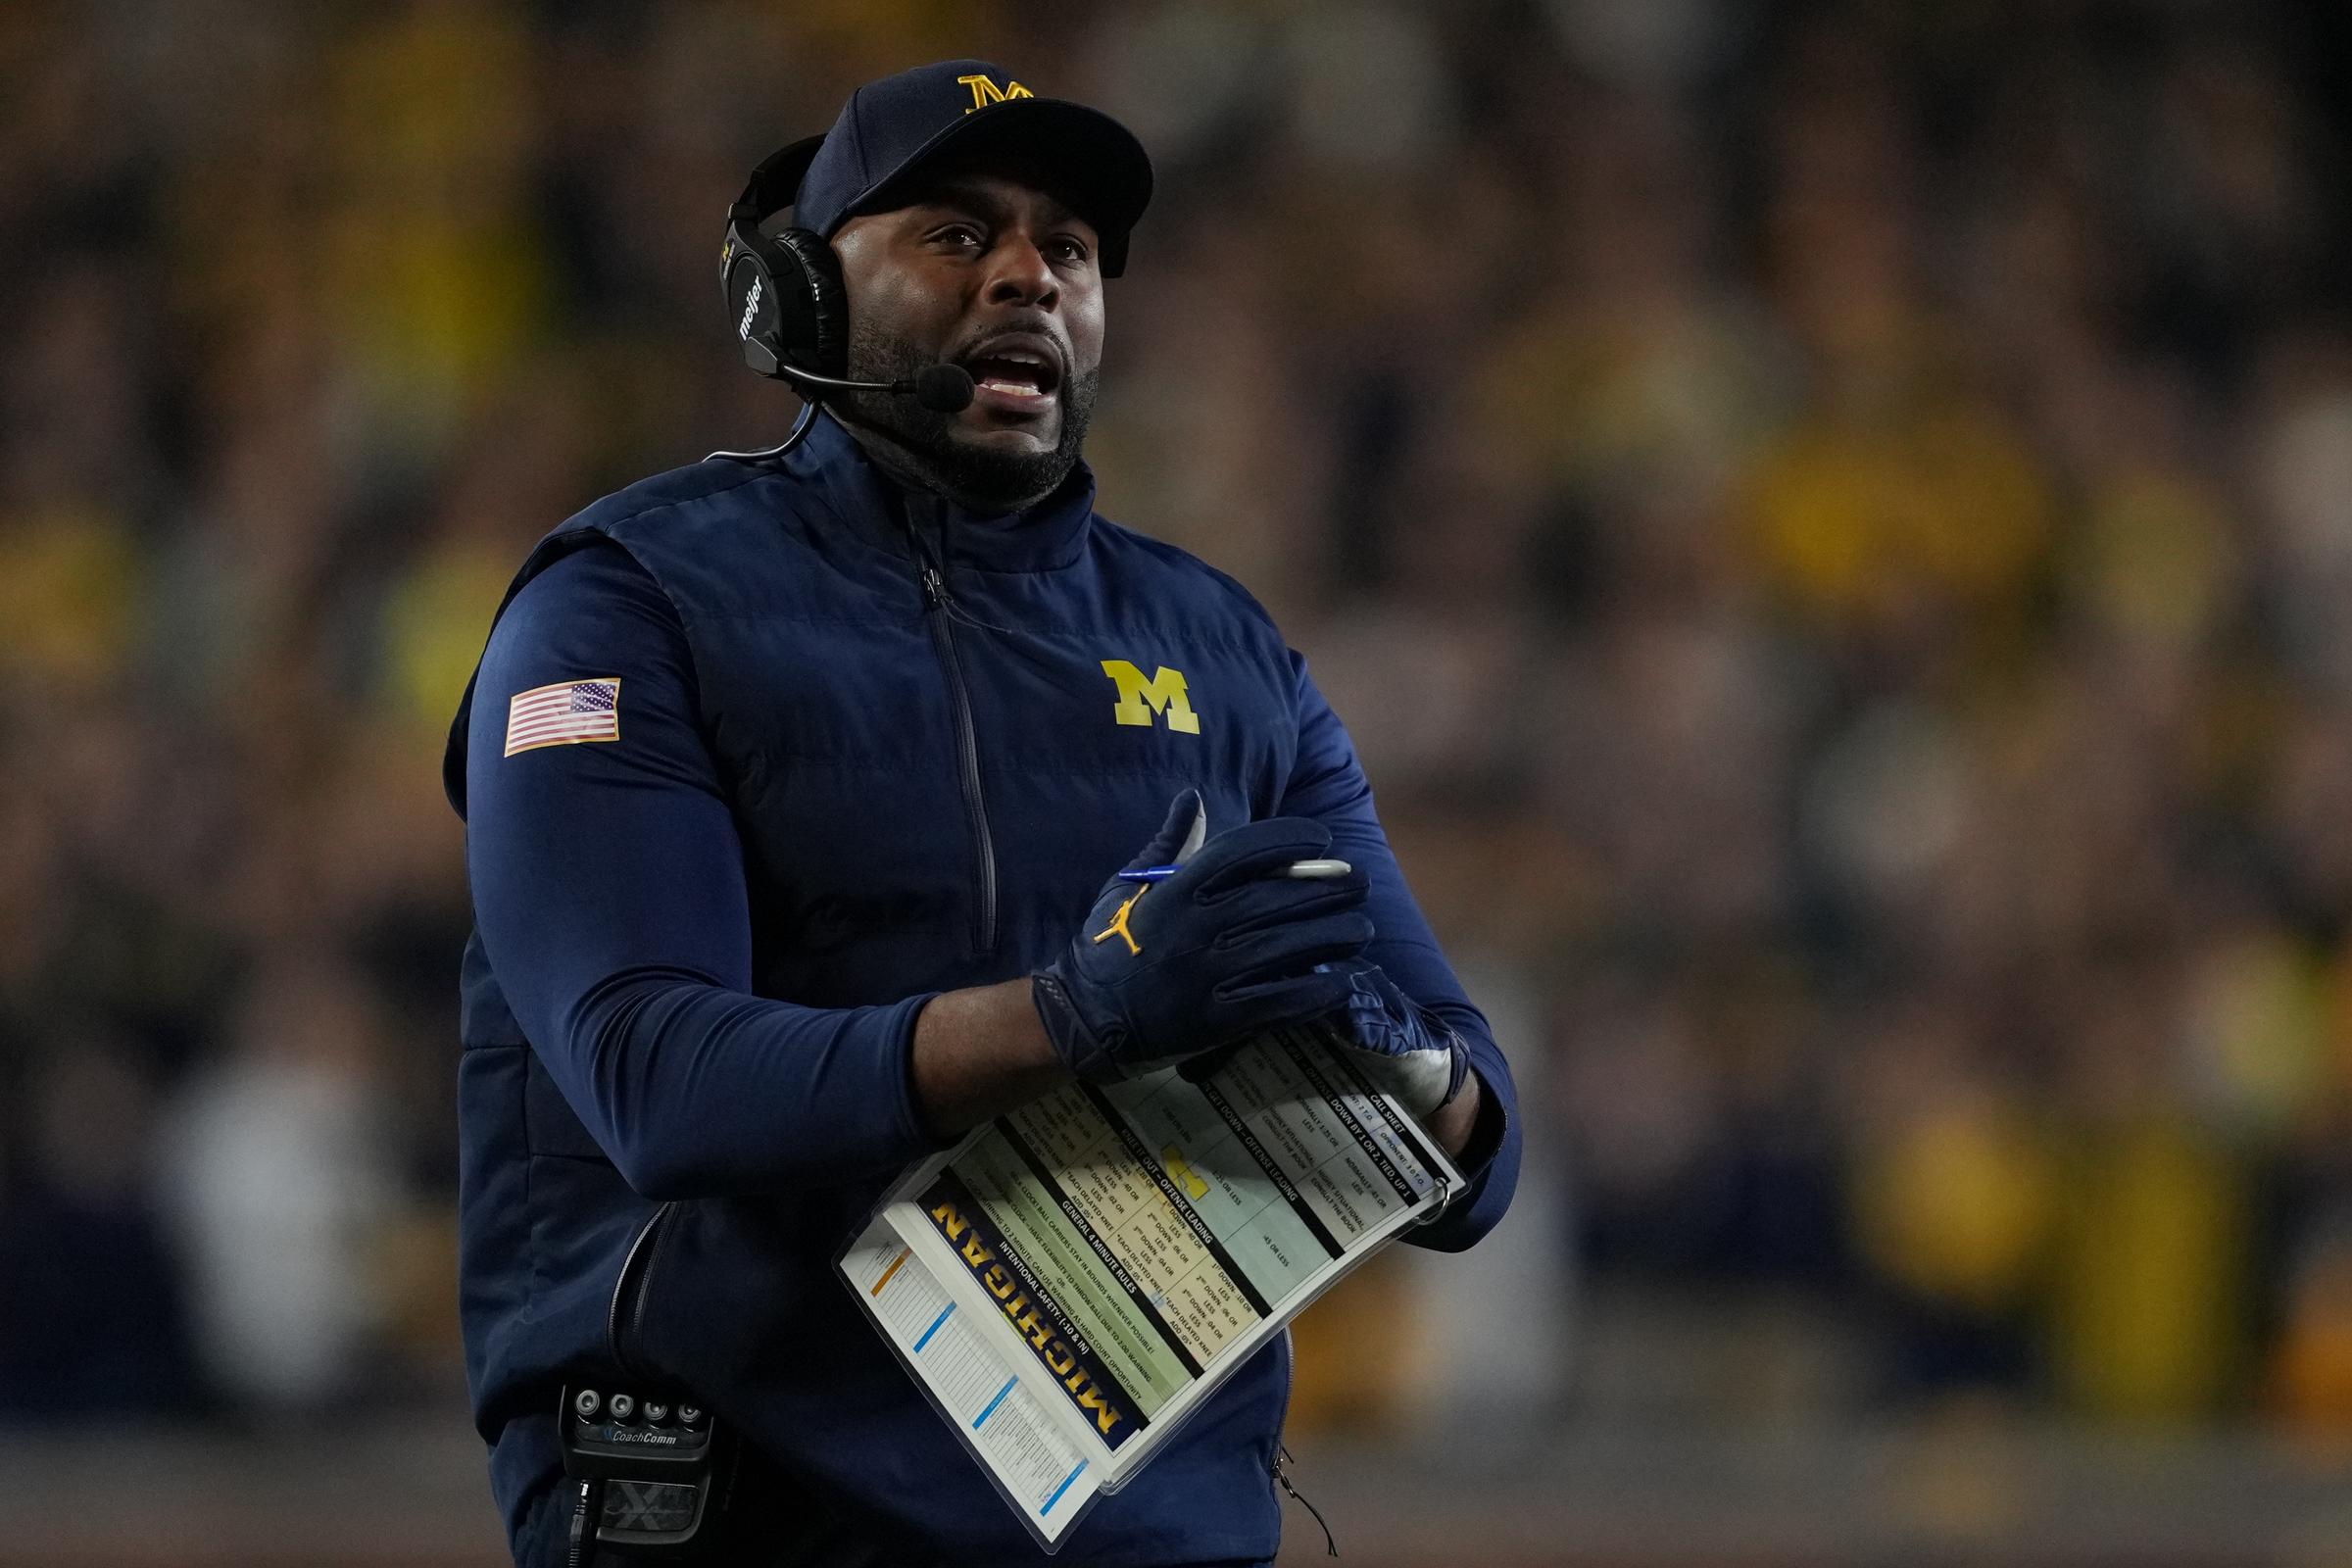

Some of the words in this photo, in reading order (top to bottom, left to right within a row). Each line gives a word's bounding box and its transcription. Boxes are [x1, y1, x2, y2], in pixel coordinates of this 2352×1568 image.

[957, 74, 1034, 114] M
[739, 275, 762, 341] meijer
[1101, 660, 1200, 735] M
[1369, 1092, 1388, 1112] CALL
[1383, 1109, 1405, 1135] SHEET
[1219, 1103, 1245, 1132] DOWN
[1244, 1135, 1273, 1169] OFFENSE
[1268, 1166, 1298, 1201] LEADING
[1330, 1098, 1353, 1125] DOWN
[1349, 1122, 1362, 1136] BY
[1362, 1139, 1376, 1152] OR
[1371, 1151, 1382, 1161] 2,
[1378, 1159, 1396, 1180] TIED,
[1393, 1178, 1406, 1192] UP
[1401, 1189, 1410, 1198] 1
[1379, 1130, 1408, 1166] OPPONENT:
[1103, 1174, 1118, 1190] LESS
[1221, 1182, 1232, 1194] OR
[1228, 1191, 1242, 1206] LESS
[1070, 1194, 1084, 1209] ADD
[1090, 1187, 1103, 1202] LESS
[1129, 1190, 1140, 1201] OR
[1142, 1155, 1158, 1174] OUT
[1158, 1177, 1189, 1212] OFFENSE
[1183, 1209, 1213, 1245] LEADING
[1310, 1176, 1333, 1204] CONSULT
[1331, 1202, 1343, 1215] THE
[1340, 1214, 1356, 1234] BOOK
[1060, 1199, 1092, 1236] GENERAL
[1079, 1189, 1102, 1216] DELAYED
[1099, 1214, 1113, 1231] KNEE
[1114, 1202, 1125, 1214] OR
[1086, 1232, 1097, 1242] 4
[1168, 1224, 1182, 1239] LESS
[1091, 1238, 1120, 1272] MINUTE
[1153, 1237, 1167, 1251] LESS
[1193, 1238, 1203, 1250] OR
[1269, 1243, 1280, 1254] OR
[1276, 1251, 1290, 1267] LESS
[1120, 1256, 1134, 1271] ADD
[1139, 1250, 1152, 1264] LESS
[1178, 1252, 1190, 1264] OR
[1036, 1205, 1051, 1222] BALL
[1047, 1219, 1071, 1249] CARRIERS
[1068, 1247, 1083, 1263] STAY
[1079, 1261, 1089, 1271] IN
[1085, 1268, 1107, 1296] BOUNDS
[1104, 1293, 1132, 1326] WHENEVER
[1129, 1325, 1154, 1354] POSSIBLE!
[1114, 1268, 1138, 1295] RULES
[1128, 1251, 1152, 1279] DELAYED
[1148, 1277, 1163, 1295] KNEE
[1163, 1265, 1174, 1277] OR
[998, 1241, 1041, 1292] INTENTIONAL
[1036, 1289, 1062, 1320] SAFETY:
[1057, 1317, 1074, 1336] (-10
[1069, 1333, 1080, 1343] &
[1075, 1340, 1090, 1354] IN)
[1027, 1225, 1044, 1244] HAVE
[1040, 1242, 1068, 1275] FLEXIBILITY
[1065, 1273, 1075, 1284] TO
[1072, 1282, 1092, 1305] THROW
[1089, 1303, 1103, 1320] BALL
[1100, 1318, 1113, 1332] DUE
[1109, 1331, 1120, 1342] TO
[1127, 1352, 1152, 1383] WARNING
[1217, 1287, 1231, 1301] LESS
[929, 1196, 1124, 1436] MICHIGAN
[1002, 1223, 1011, 1234] TO
[1031, 1260, 1044, 1275] CAN
[1041, 1273, 1053, 1287] USE
[1050, 1285, 1075, 1315] WARNING
[1072, 1314, 1082, 1324] AS
[1078, 1322, 1095, 1341] HARD
[1092, 1339, 1110, 1361] COUNT
[1107, 1359, 1142, 1400] OPPORTUNITY
[1202, 1299, 1216, 1314] LESS
[1242, 1301, 1252, 1313] OR
[1169, 1319, 1183, 1335] ADD
[1188, 1312, 1201, 1328] LESS
[1227, 1315, 1239, 1327] OR
[1178, 1315, 1200, 1342] DELAYED
[1198, 1340, 1212, 1357] KNEE
[1212, 1328, 1224, 1340] OR
[612, 1430, 676, 1446] CoachComm
